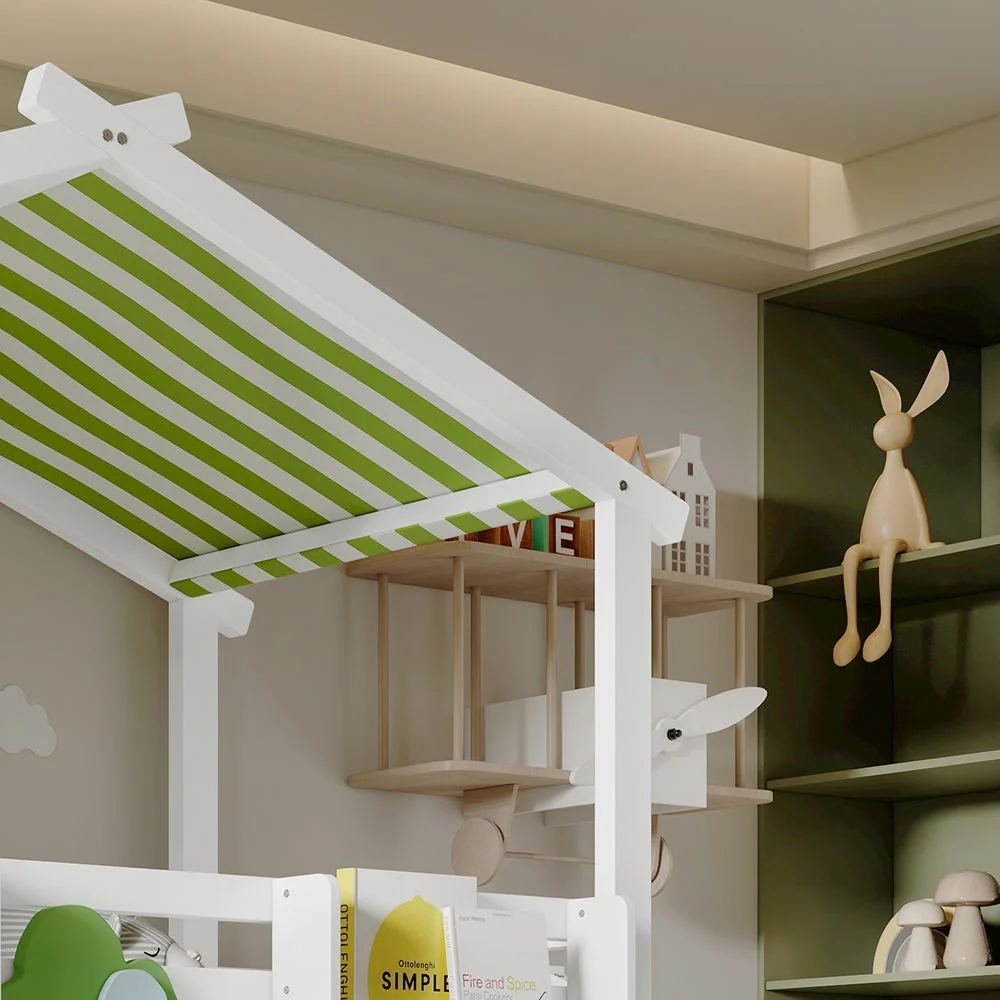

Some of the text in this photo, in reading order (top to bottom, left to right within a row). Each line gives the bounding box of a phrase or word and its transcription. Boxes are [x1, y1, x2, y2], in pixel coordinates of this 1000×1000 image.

[398, 960, 436, 971] Ottolenghi
[382, 971, 450, 993] SIMPLE
[462, 973, 536, 993] Fire and Spice
